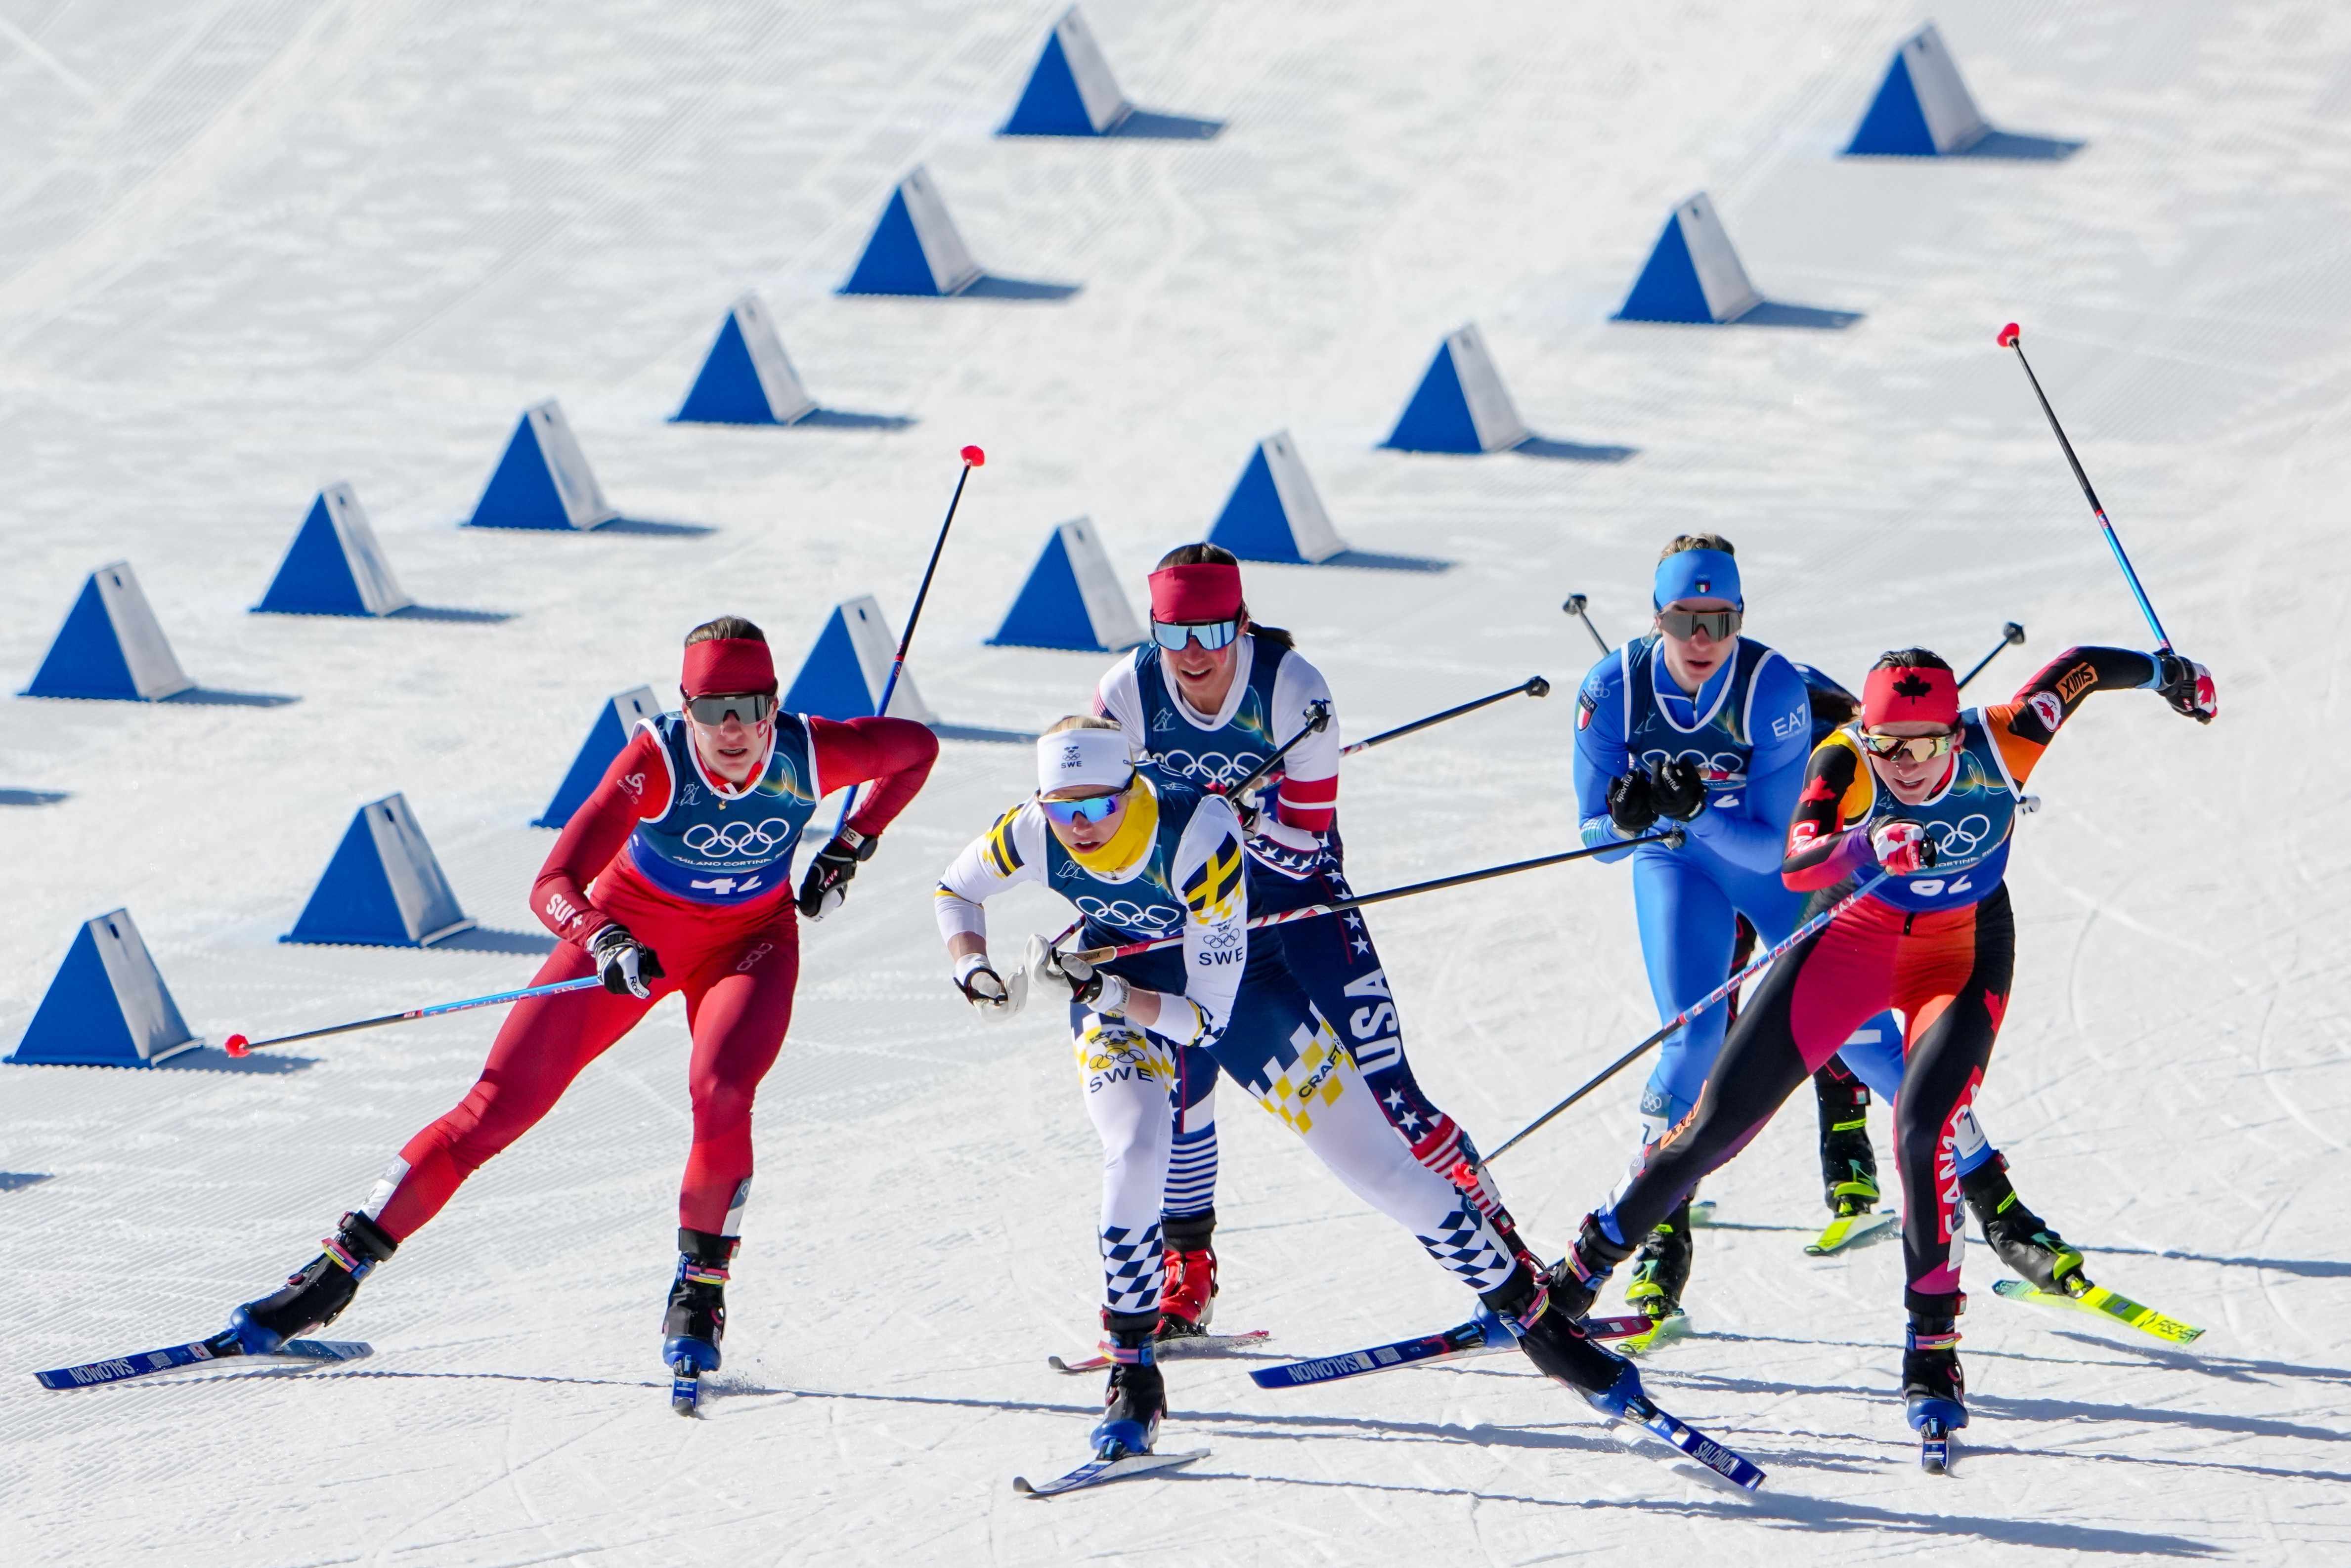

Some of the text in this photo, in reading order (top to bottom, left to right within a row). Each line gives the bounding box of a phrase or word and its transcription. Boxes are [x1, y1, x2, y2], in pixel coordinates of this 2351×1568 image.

[1771, 703, 1806, 737] EA7
[1061, 761, 1083, 769] SWE
[1616, 774, 1633, 803] sportful
[672, 855, 721, 866] MILANO
[723, 858, 772, 867] CORTINA
[1199, 946, 1243, 966] SWE
[1343, 968, 1402, 1077] USA
[1089, 1066, 1154, 1094] SWE
[1298, 1044, 1342, 1098] CRAFT
[2152, 1319, 2199, 1345] FISCHER
[1584, 1339, 1621, 1362] SALOMON
[68, 1358, 135, 1385] SALOMON
[1286, 1353, 1360, 1383] SALOMON
[1692, 1440, 1742, 1477] SALOMON
